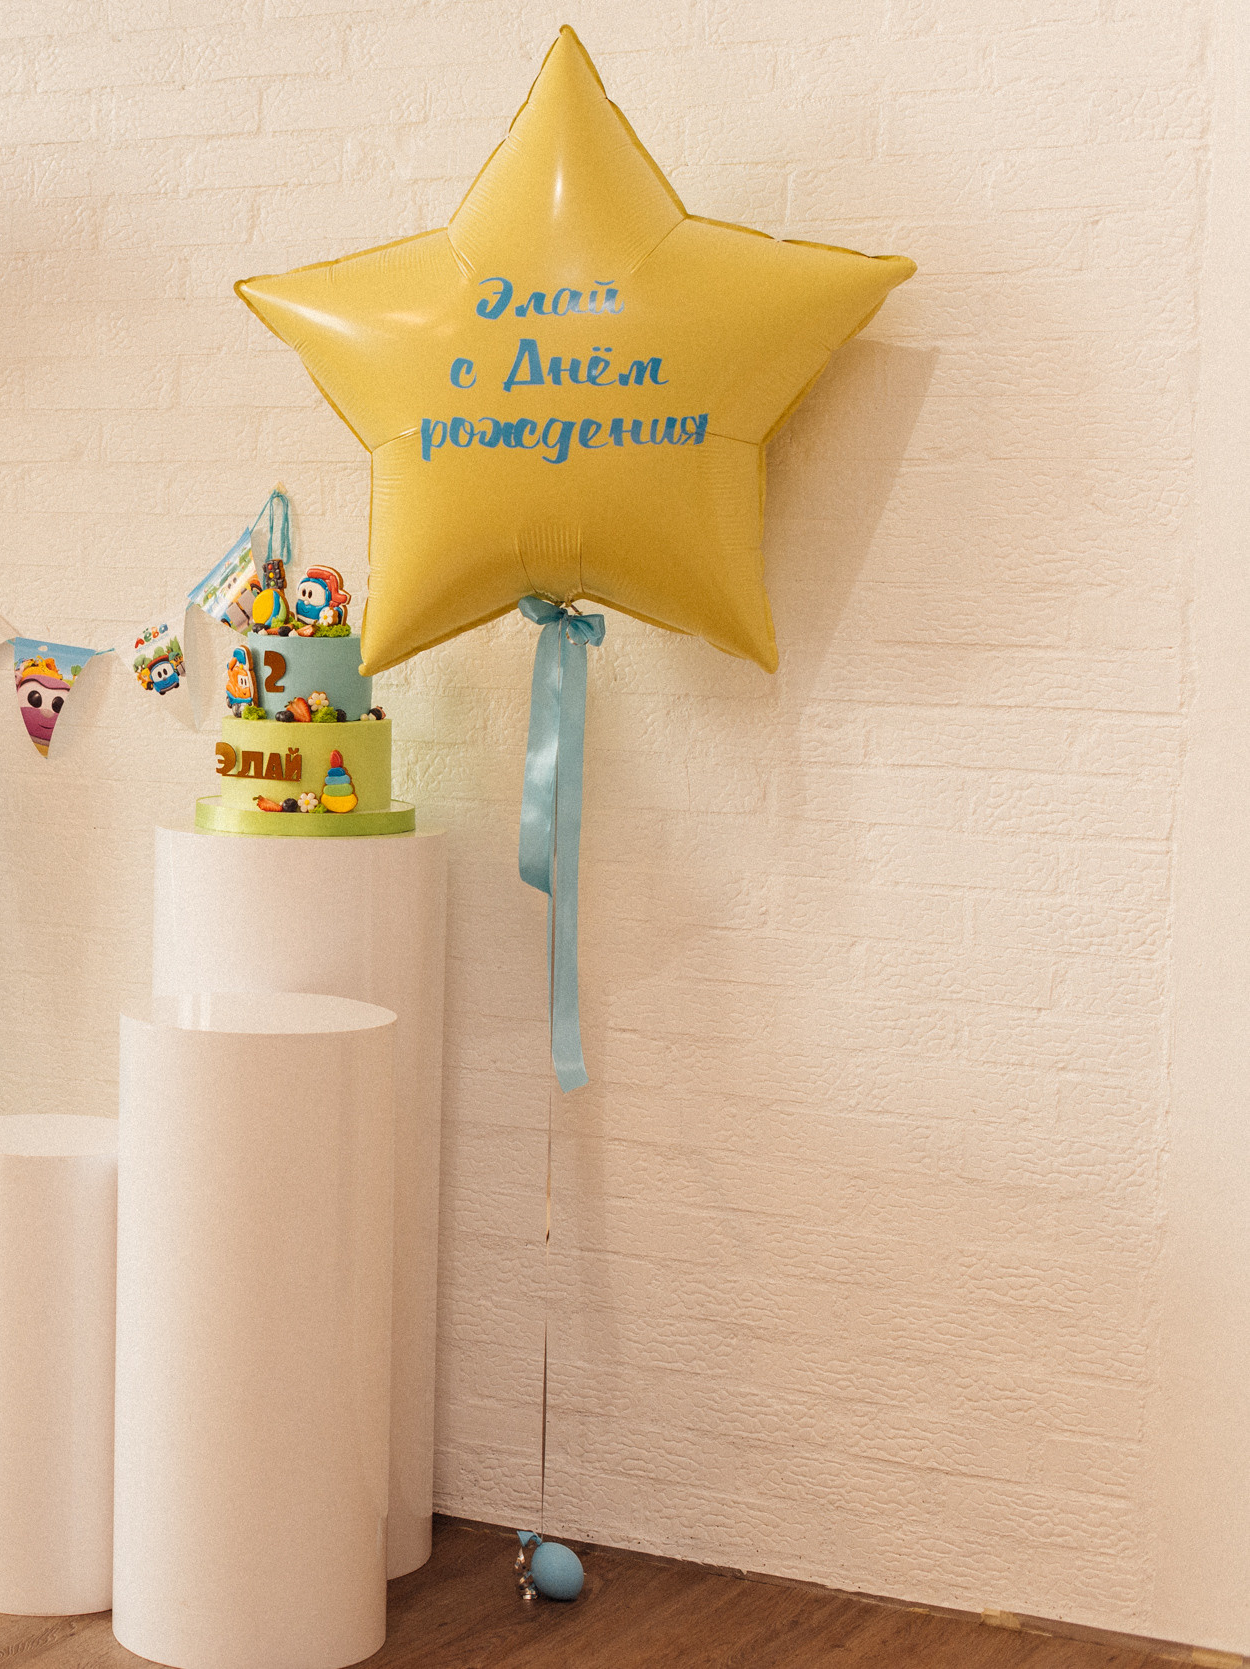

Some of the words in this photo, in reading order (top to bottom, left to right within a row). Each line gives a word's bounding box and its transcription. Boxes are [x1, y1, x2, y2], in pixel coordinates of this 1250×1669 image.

[475, 276, 625, 320] Элай
[449, 357, 477, 389] с
[502, 338, 670, 393] Днём
[420, 413, 710, 465] рождения
[263, 650, 287, 693] 2
